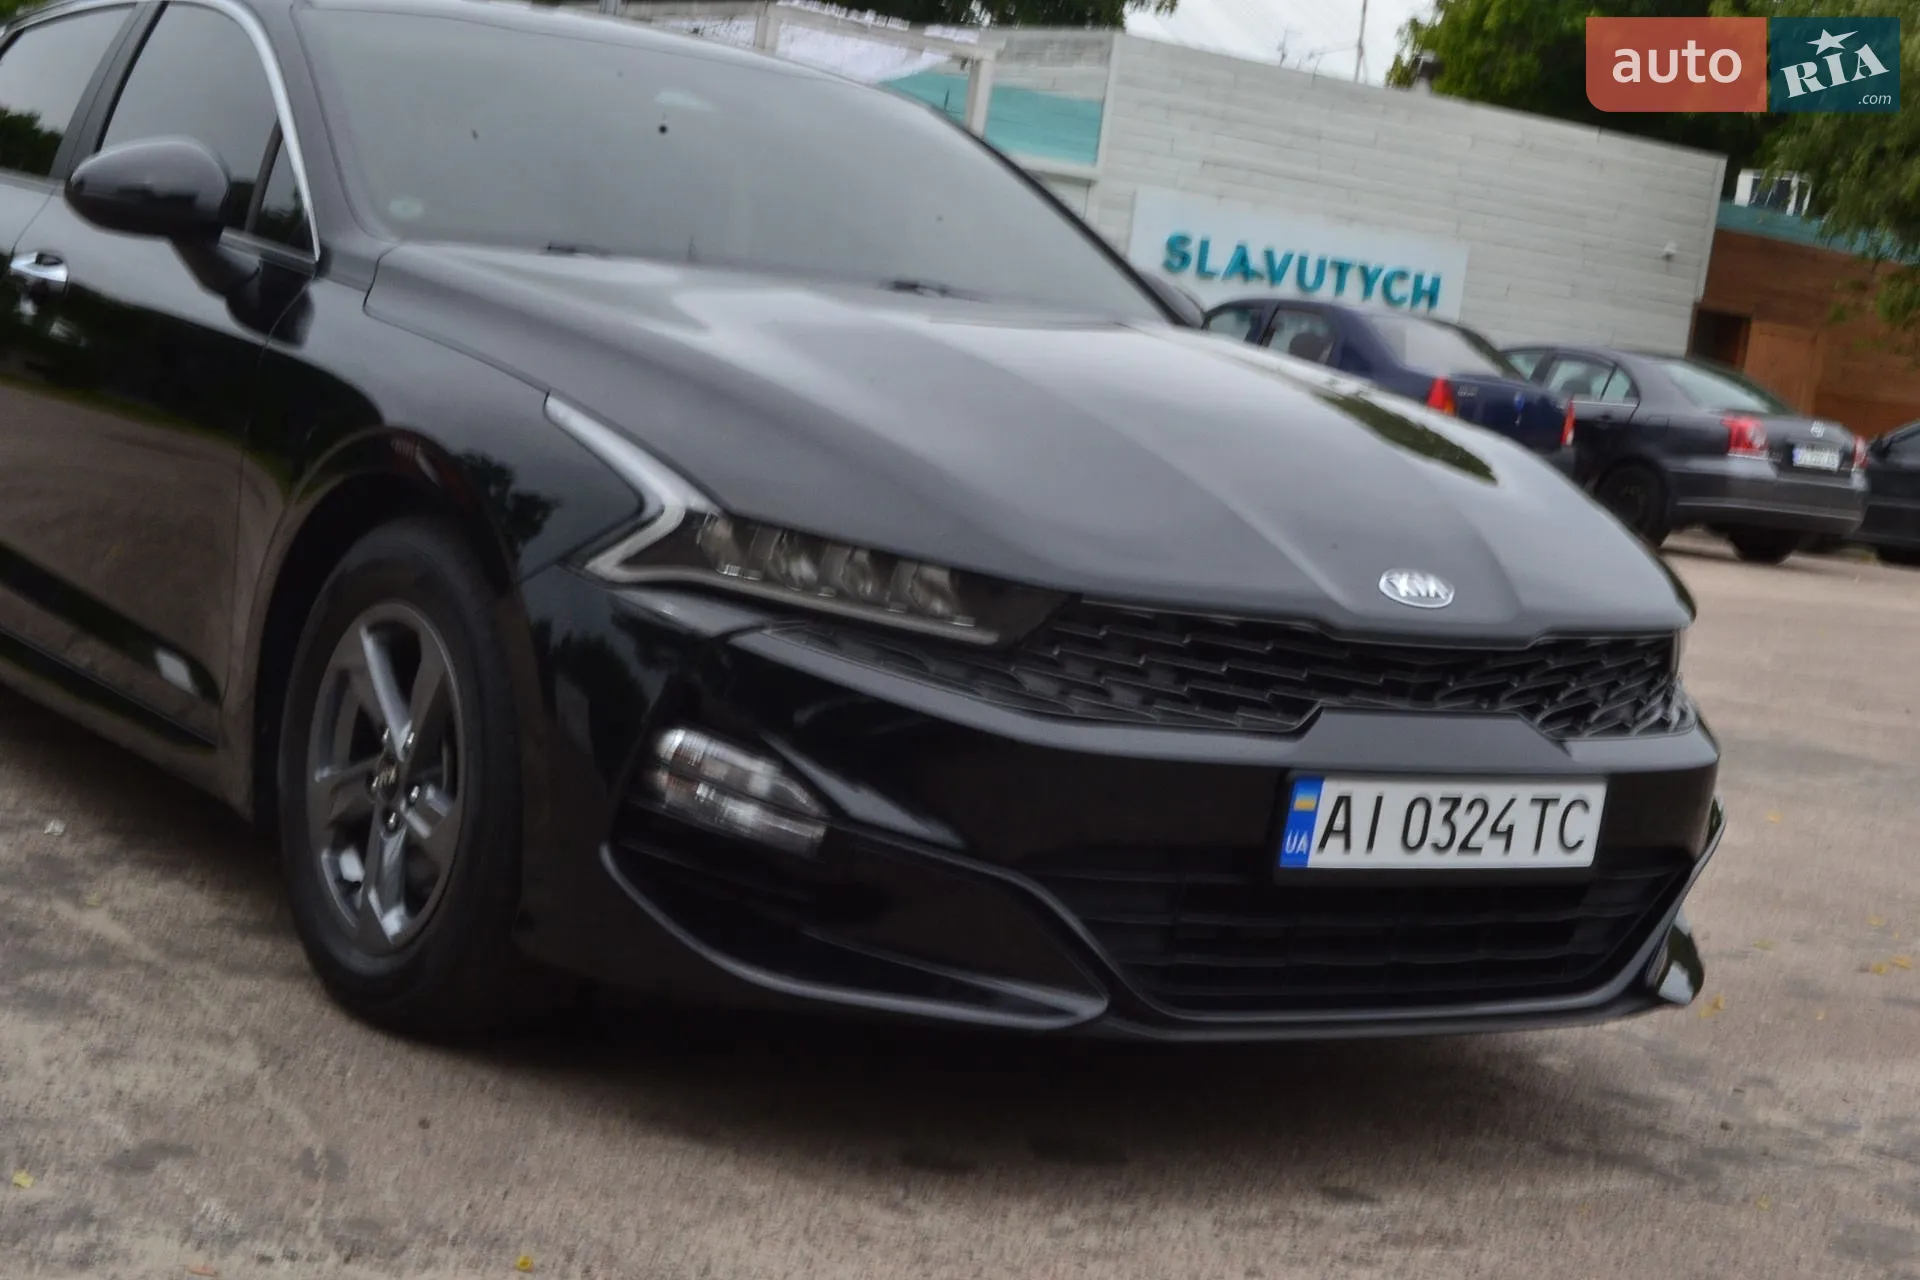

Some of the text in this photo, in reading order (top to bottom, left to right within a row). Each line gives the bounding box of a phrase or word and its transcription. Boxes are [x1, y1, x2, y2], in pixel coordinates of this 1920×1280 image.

[1163, 231, 1441, 312] SLAVUTYCH
[1285, 831, 1308, 856] UA
[1401, 796, 1516, 856] 0324
[1530, 798, 1591, 856] TC
